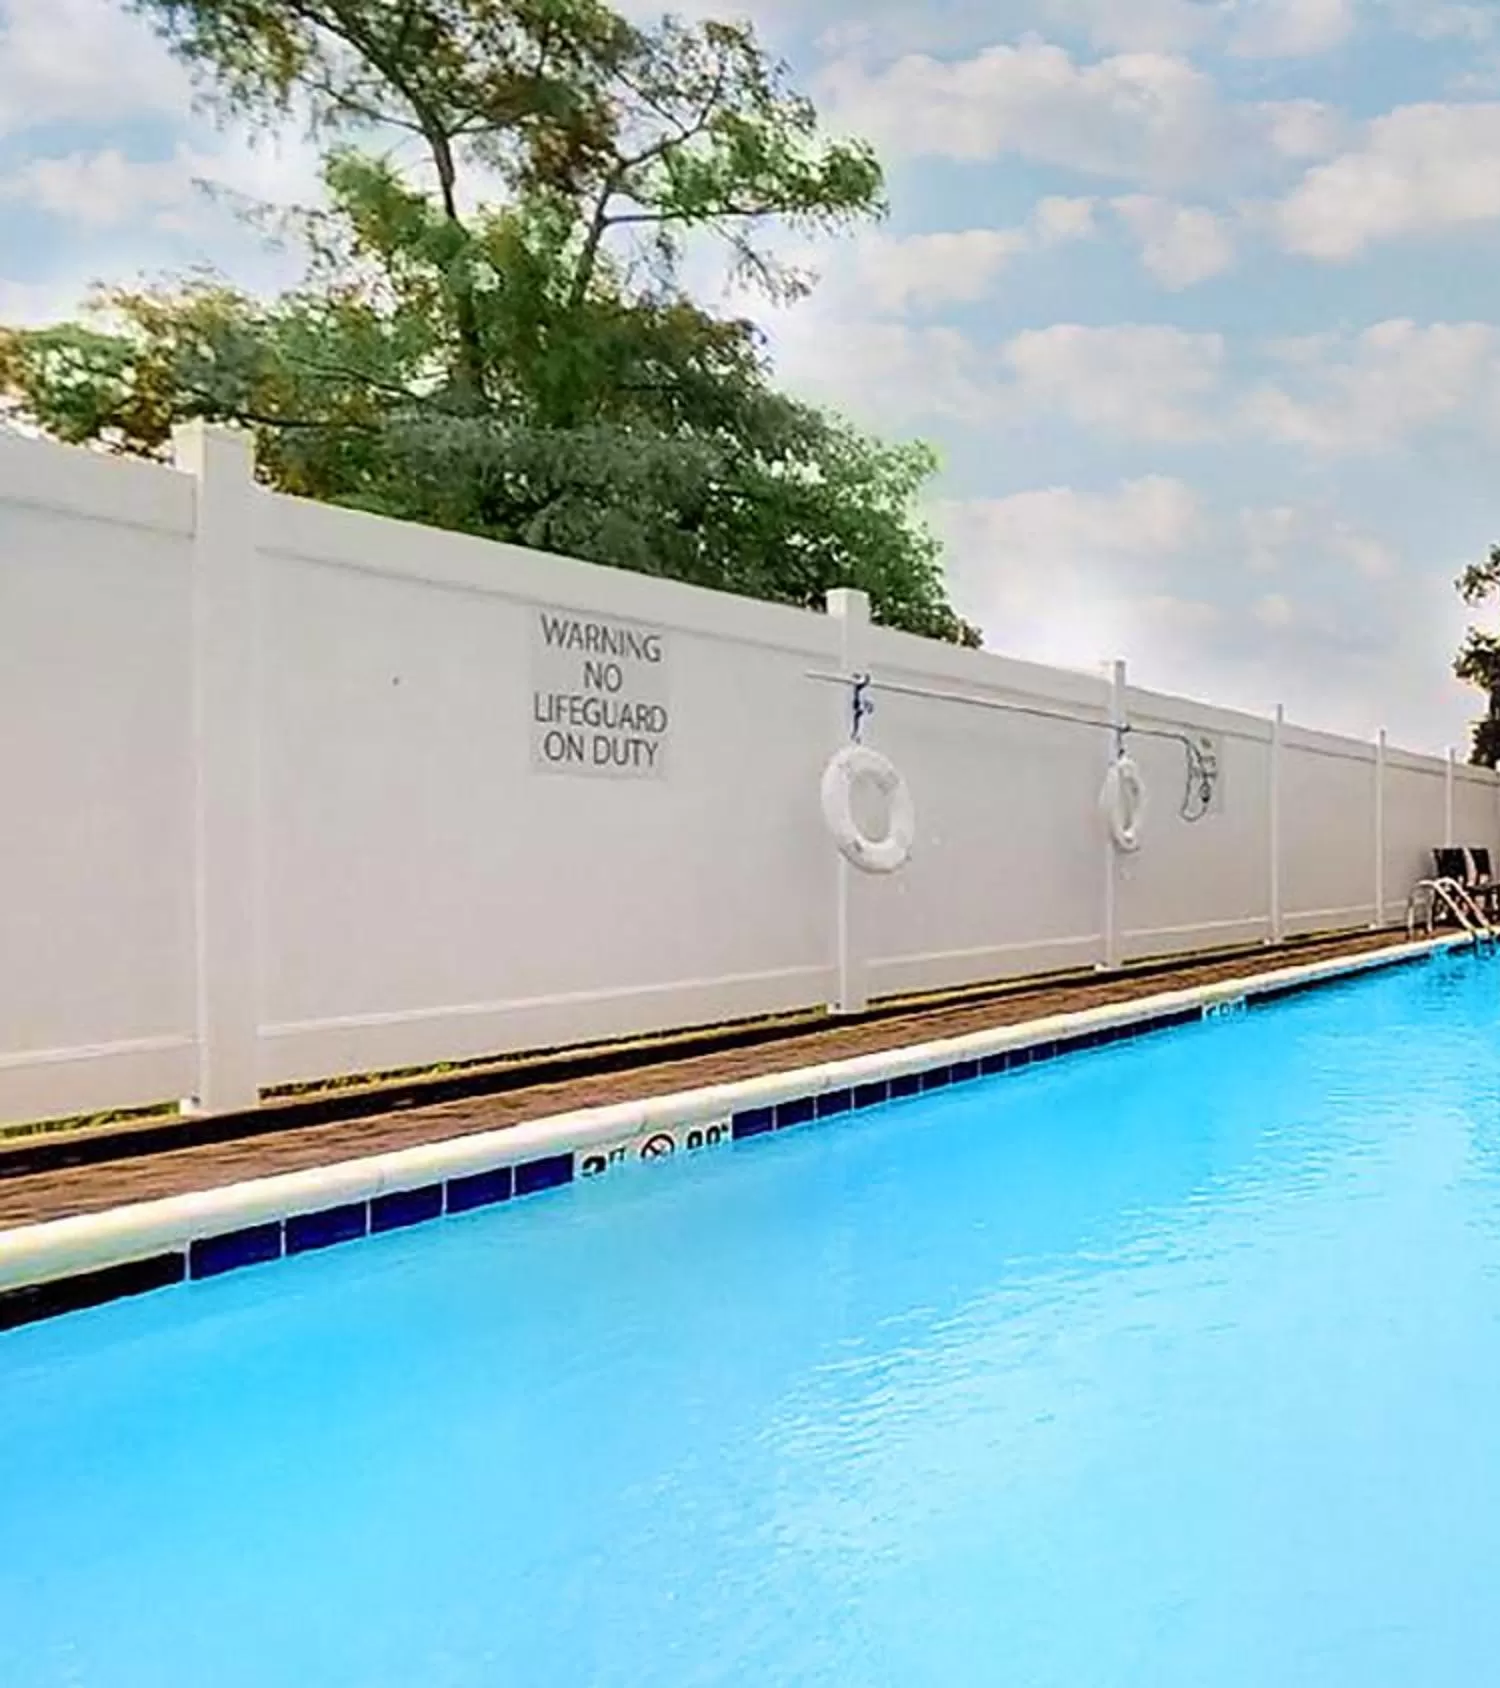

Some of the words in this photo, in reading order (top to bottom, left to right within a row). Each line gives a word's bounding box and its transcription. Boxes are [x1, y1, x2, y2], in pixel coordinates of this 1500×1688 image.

[540, 612, 662, 663] WARNING
[583, 660, 623, 693] NO
[534, 691, 668, 733] LIFEGUARD
[544, 730, 584, 761] ON
[593, 735, 659, 768] DUTY
